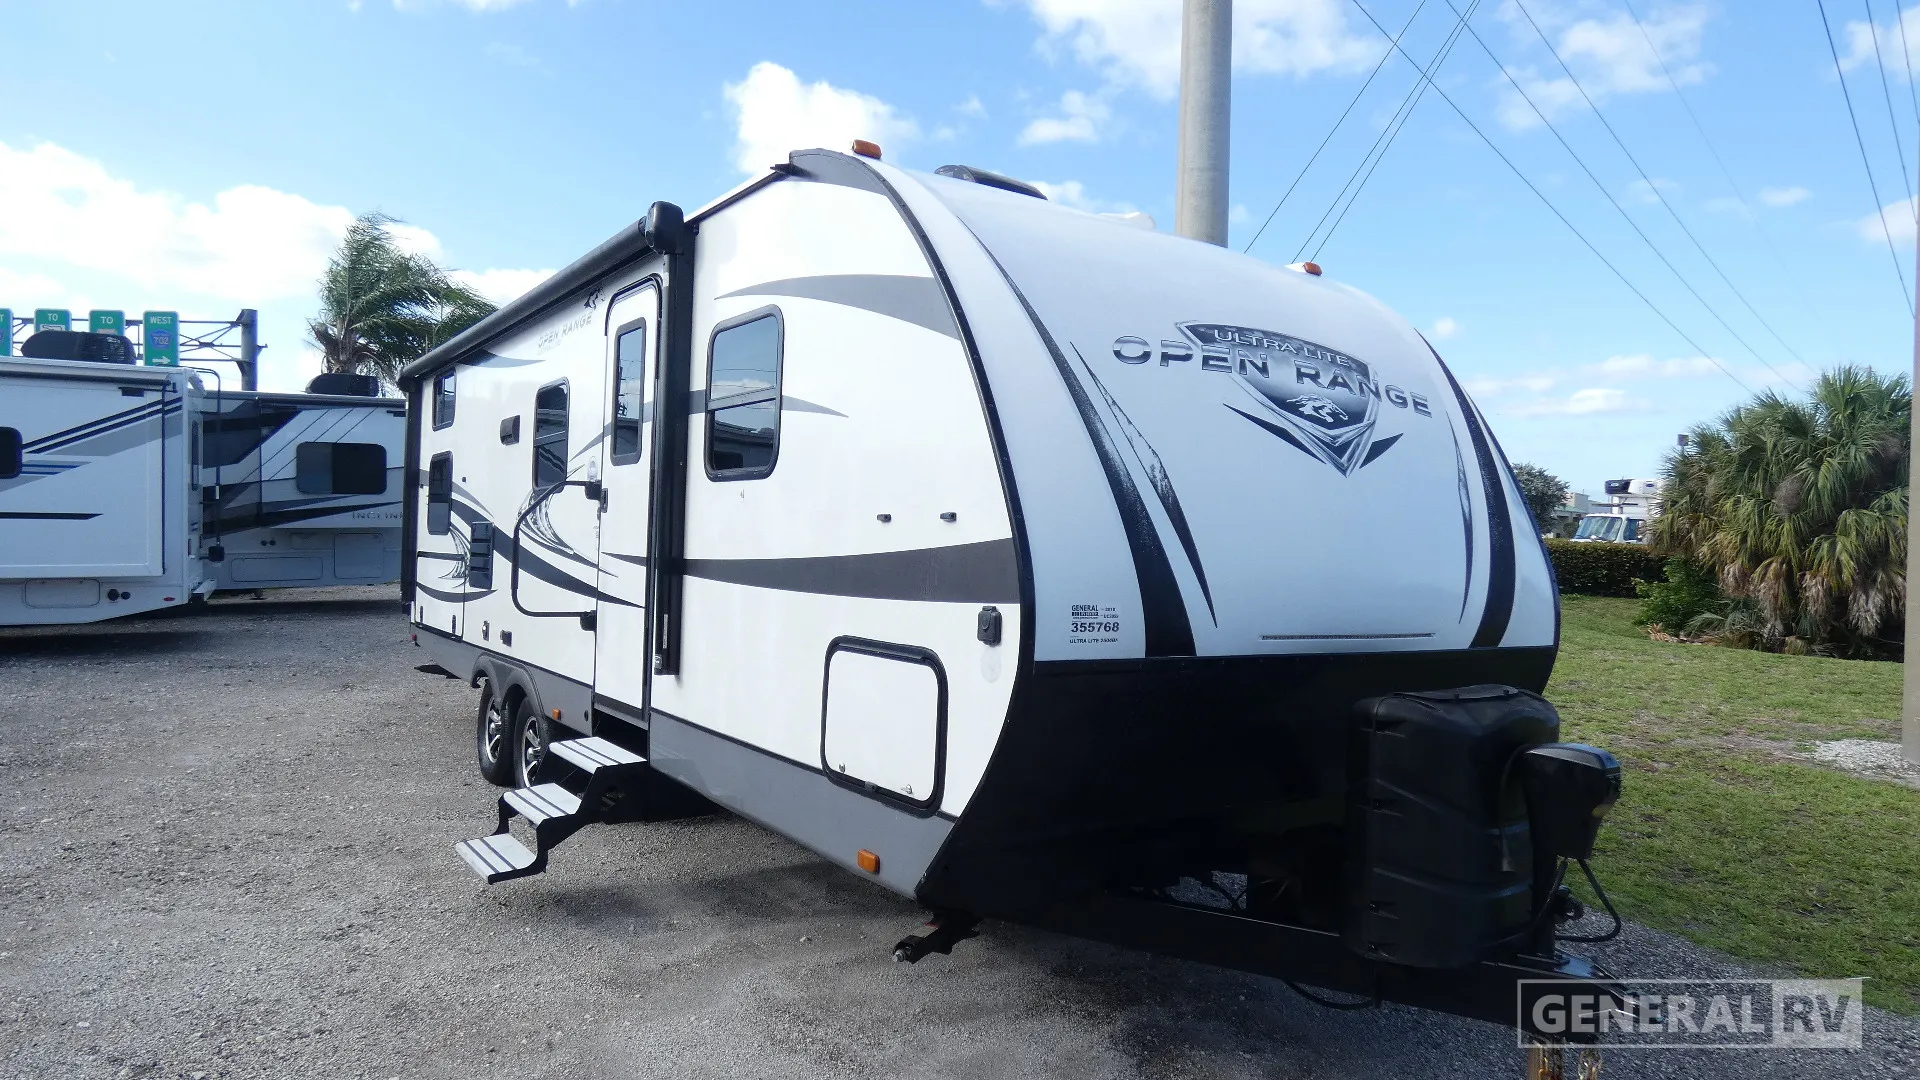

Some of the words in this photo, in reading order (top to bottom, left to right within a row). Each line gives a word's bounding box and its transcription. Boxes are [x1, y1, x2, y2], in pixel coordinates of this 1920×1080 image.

[48, 313, 58, 321] TO
[100, 316, 114, 325] TO
[150, 316, 172, 324] WEST
[562, 315, 592, 336] RANGE
[153, 336, 169, 345] 702
[1213, 328, 1298, 355] ULTRA
[1303, 345, 1350, 366] LITE
[1112, 335, 1269, 378] OPEN
[1296, 359, 1433, 418] RANGE
[1071, 604, 1099, 612] GENERAL
[1071, 621, 1120, 633] 355768
